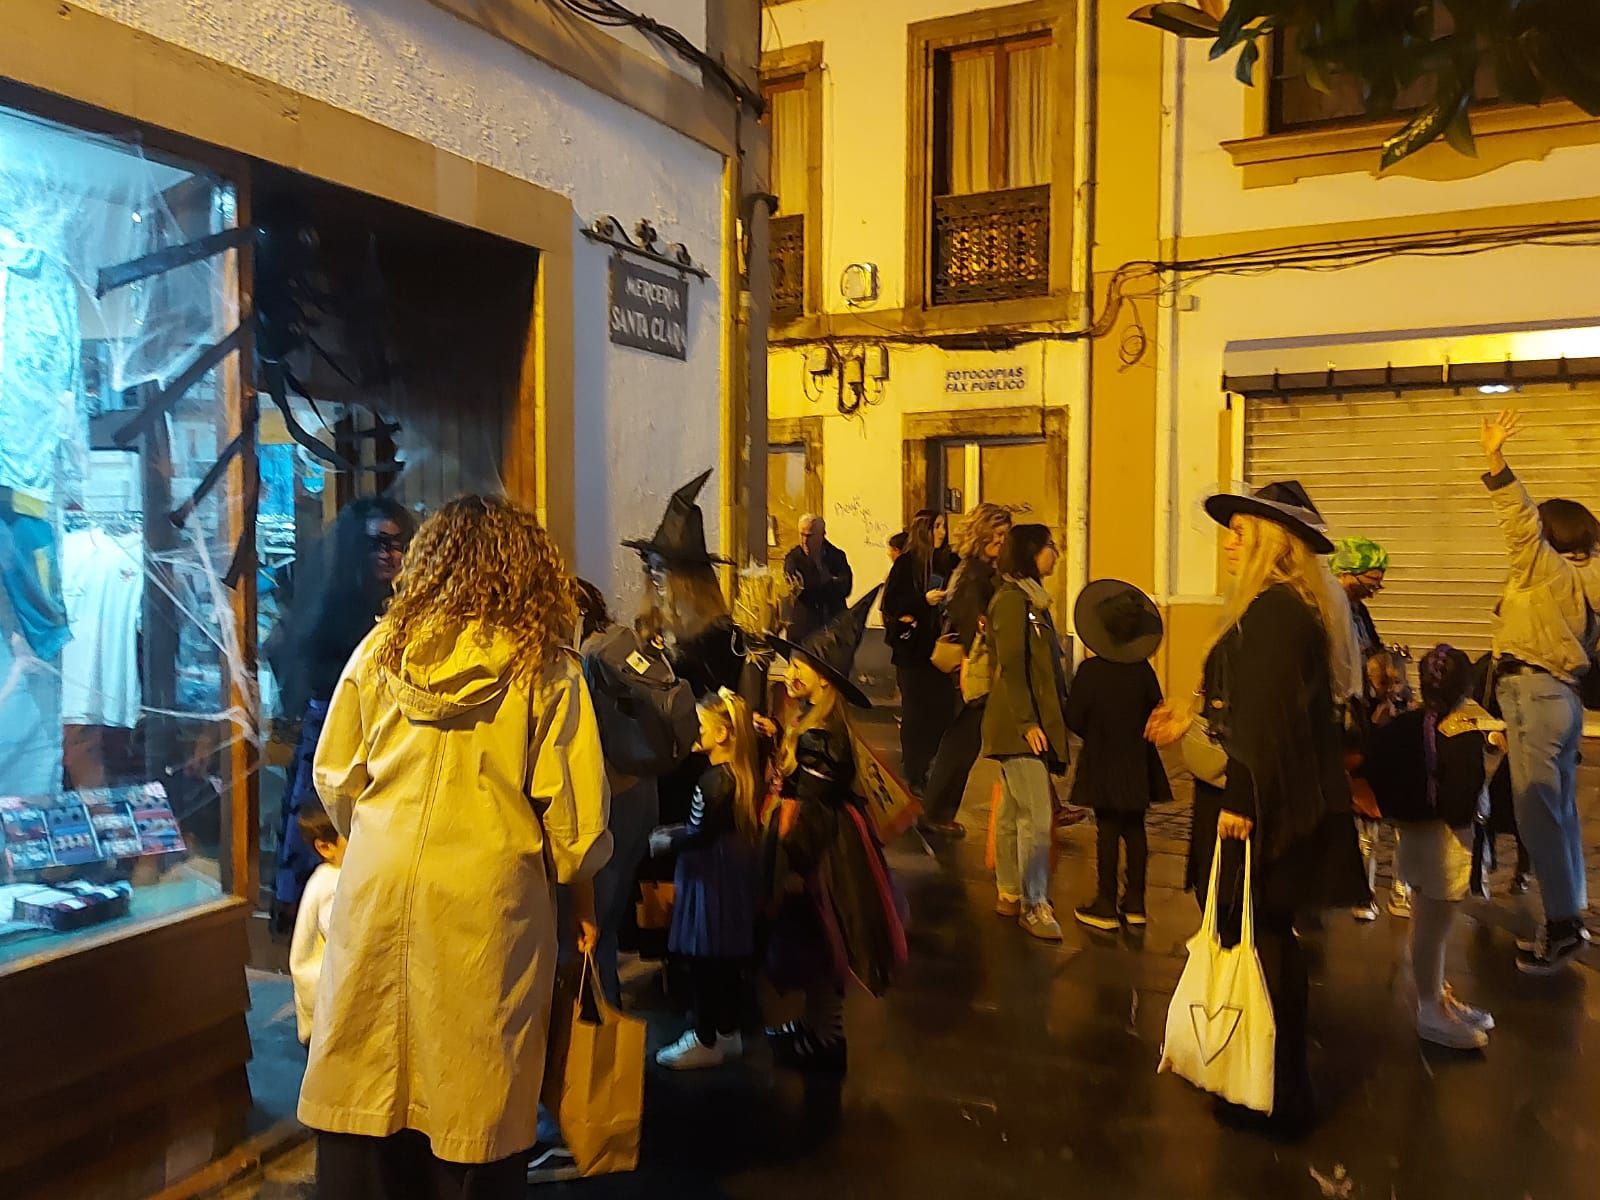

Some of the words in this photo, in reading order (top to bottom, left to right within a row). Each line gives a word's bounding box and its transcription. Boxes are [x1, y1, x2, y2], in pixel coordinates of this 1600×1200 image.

[611, 305, 649, 339] SANTA
[946, 367, 1023, 381] FOTOCOPIAS
[945, 383, 967, 393] FAX
